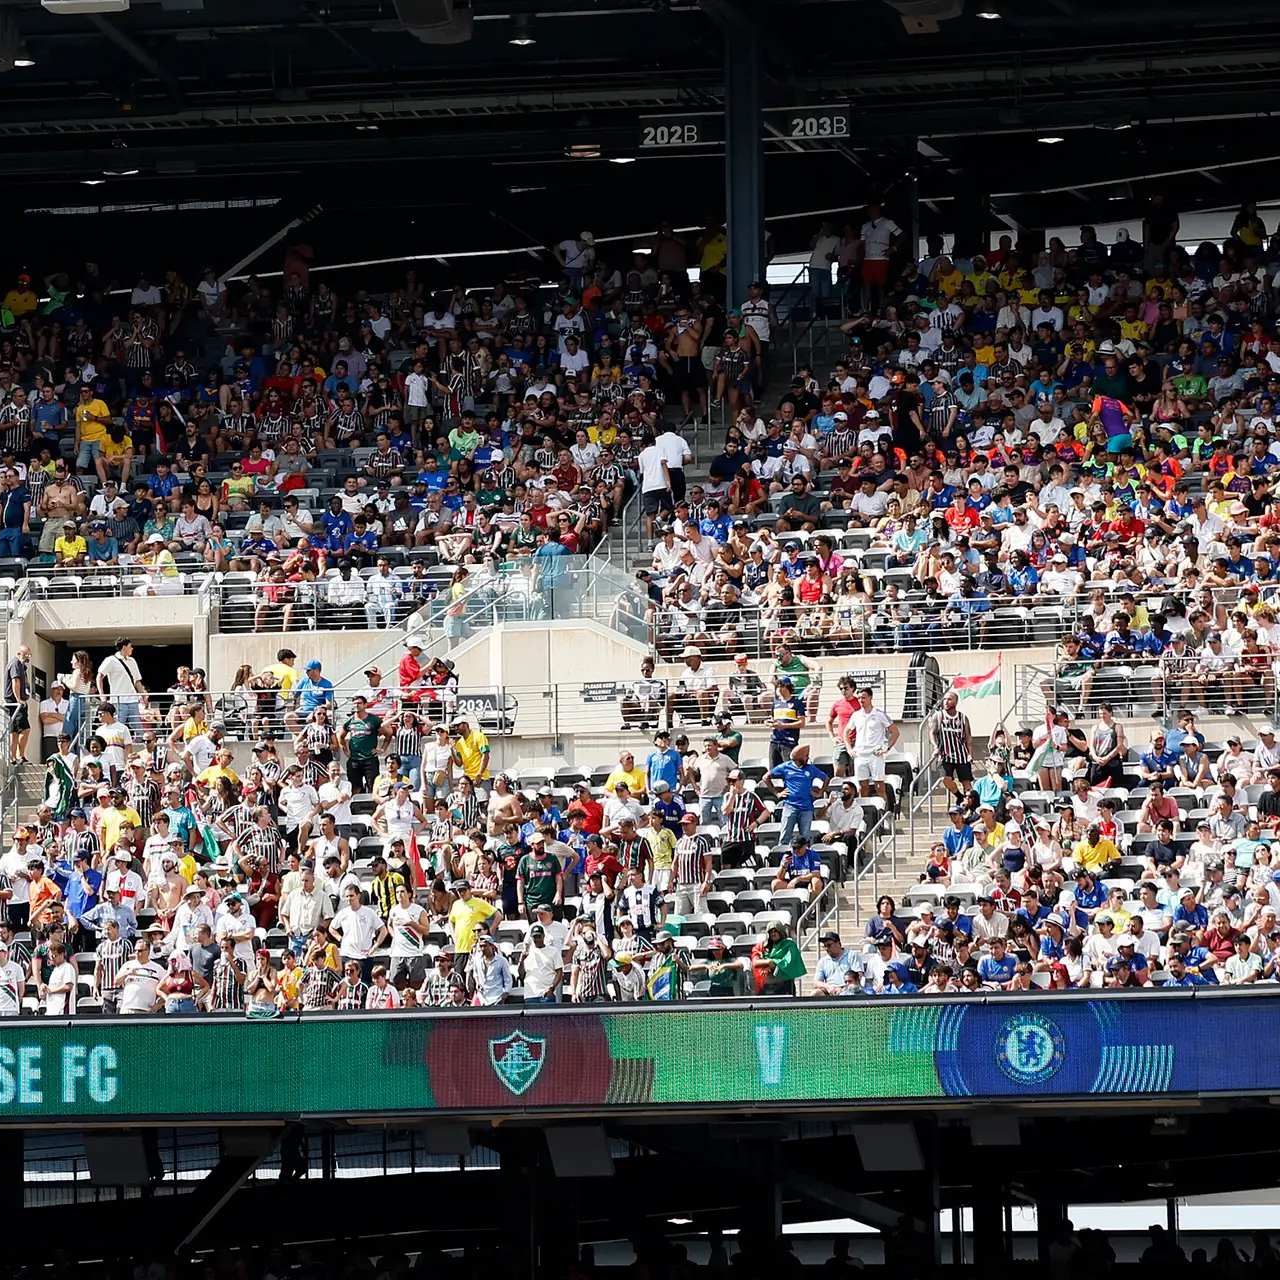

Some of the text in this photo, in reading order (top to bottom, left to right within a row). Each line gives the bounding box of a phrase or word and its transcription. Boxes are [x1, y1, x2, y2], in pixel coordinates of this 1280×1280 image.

[643, 125, 698, 145] 202B
[792, 116, 847, 136] 203B
[458, 698, 493, 712] 203A
[754, 1025, 785, 1085] V
[62, 1044, 120, 1104] FC
